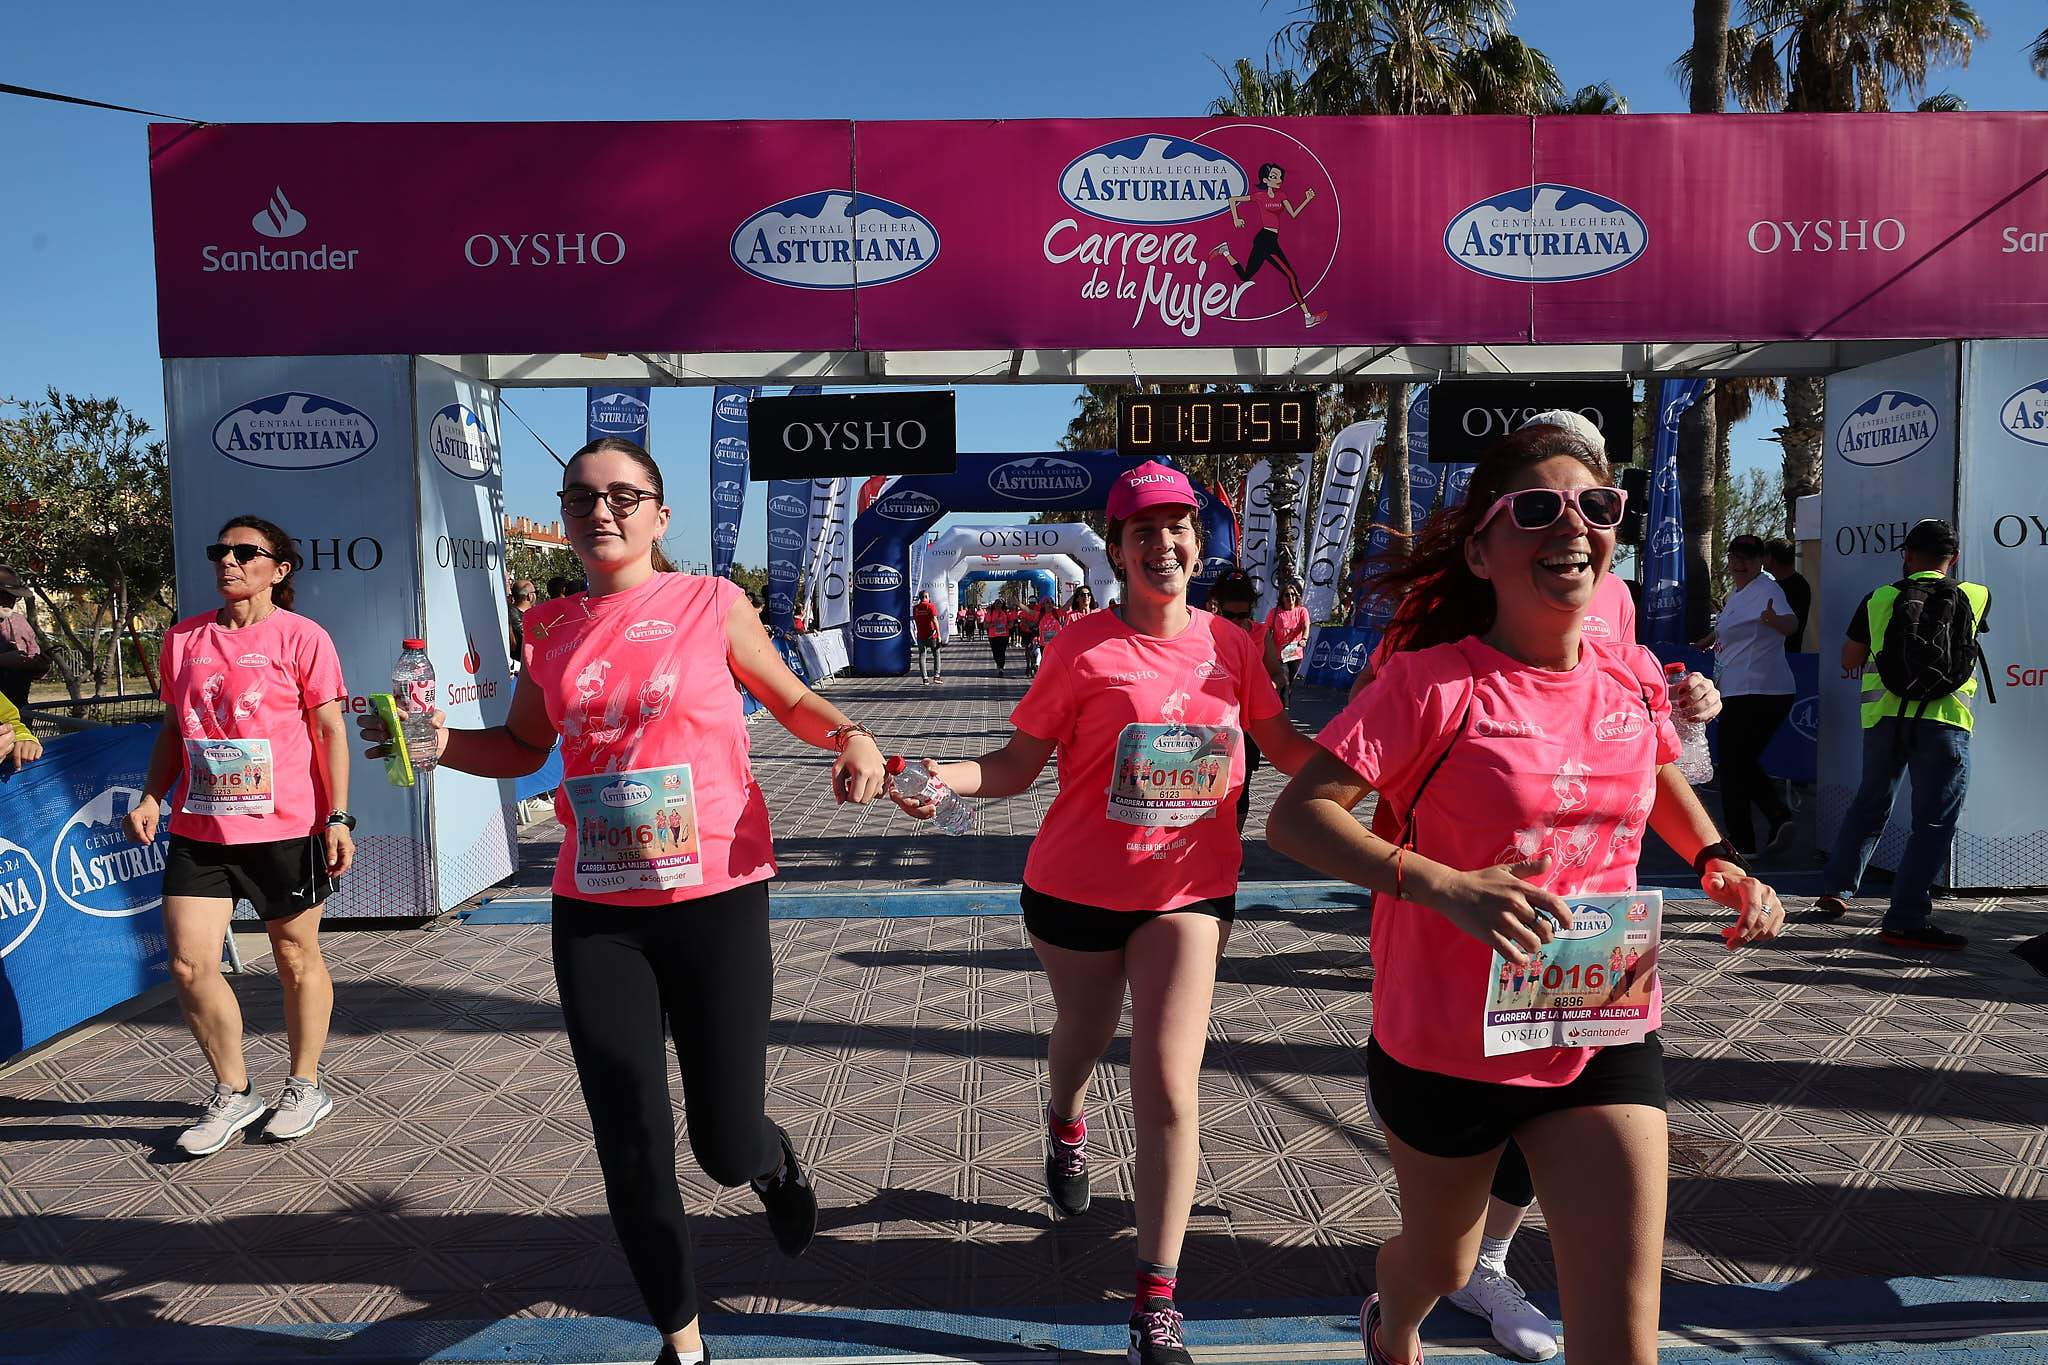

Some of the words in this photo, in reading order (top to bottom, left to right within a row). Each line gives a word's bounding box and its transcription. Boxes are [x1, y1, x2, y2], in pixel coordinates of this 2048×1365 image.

[1103, 166, 1161, 174] CENTRAL
[1168, 165, 1228, 174] LECHERA
[1074, 168, 1231, 201] ASTURIANA
[779, 225, 843, 234] CENTRAL
[1491, 218, 1555, 227] CENTRAL
[1561, 217, 1626, 227] LECHERA
[1043, 218, 1198, 265] Carrera
[1460, 220, 1632, 257] ASTURIANA
[1748, 217, 1906, 254] OYSHO
[464, 232, 626, 267] OYSHO
[747, 228, 924, 264] ASTURIANA
[202, 244, 359, 272] Santander
[1081, 267, 1107, 299] de
[1110, 267, 1136, 299] la
[1133, 261, 1255, 336] Mujer
[719, 403, 748, 416] ASTURIA
[250, 420, 302, 428] CENTRAL
[308, 418, 360, 427] LECHERA
[1857, 417, 1888, 429] CENTRAL
[1891, 409, 1926, 422] LECHERA
[226, 422, 366, 451] ASTURIANA
[782, 420, 926, 452] OYSHO
[1842, 420, 1929, 453] ASTURIANA
[436, 424, 491, 466] ASTURIANA
[996, 471, 1084, 489] ASTURIANA
[1130, 474, 1174, 487] DRUNI
[880, 502, 935, 513] ASTURIANA
[979, 530, 1059, 547] OYSHO
[1836, 522, 1907, 556] OYSH
[436, 536, 497, 571] OYSHO
[855, 575, 899, 585] ASTURIANA
[855, 623, 899, 633] ASTURIANA
[1109, 670, 1158, 685] OYSHO
[448, 678, 498, 706] Santander
[1156, 738, 1199, 748] ASTURIANA
[209, 773, 242, 786] 016
[665, 775, 678, 785] 20
[1152, 769, 1194, 786] 016
[602, 791, 648, 802] ASTURIANA
[1115, 796, 1145, 807] CARRERA
[1156, 799, 1164, 807] LA
[1165, 799, 1186, 807] MUJER
[1160, 791, 1180, 799] 6123
[1120, 810, 1157, 820] OYSHO
[608, 825, 654, 847] 016
[618, 850, 640, 860] 3155
[581, 863, 606, 872] CARRERA
[628, 861, 650, 869] MUJER
[656, 855, 691, 867] VALENCIA
[587, 876, 625, 888] OYSHO
[648, 872, 687, 882] Santander
[1630, 903, 1645, 914] 20
[1542, 963, 1605, 989] 016
[1554, 997, 1584, 1007] 8896
[1494, 1012, 1532, 1023] CARRERA
[1535, 1011, 1546, 1021] DE
[1548, 1010, 1559, 1019] LA
[1562, 1009, 1591, 1019] MUJER
[1599, 1008, 1640, 1018] VALENCIA
[1502, 1028, 1549, 1043] OYSHO
[1581, 1027, 1629, 1038] Santander
